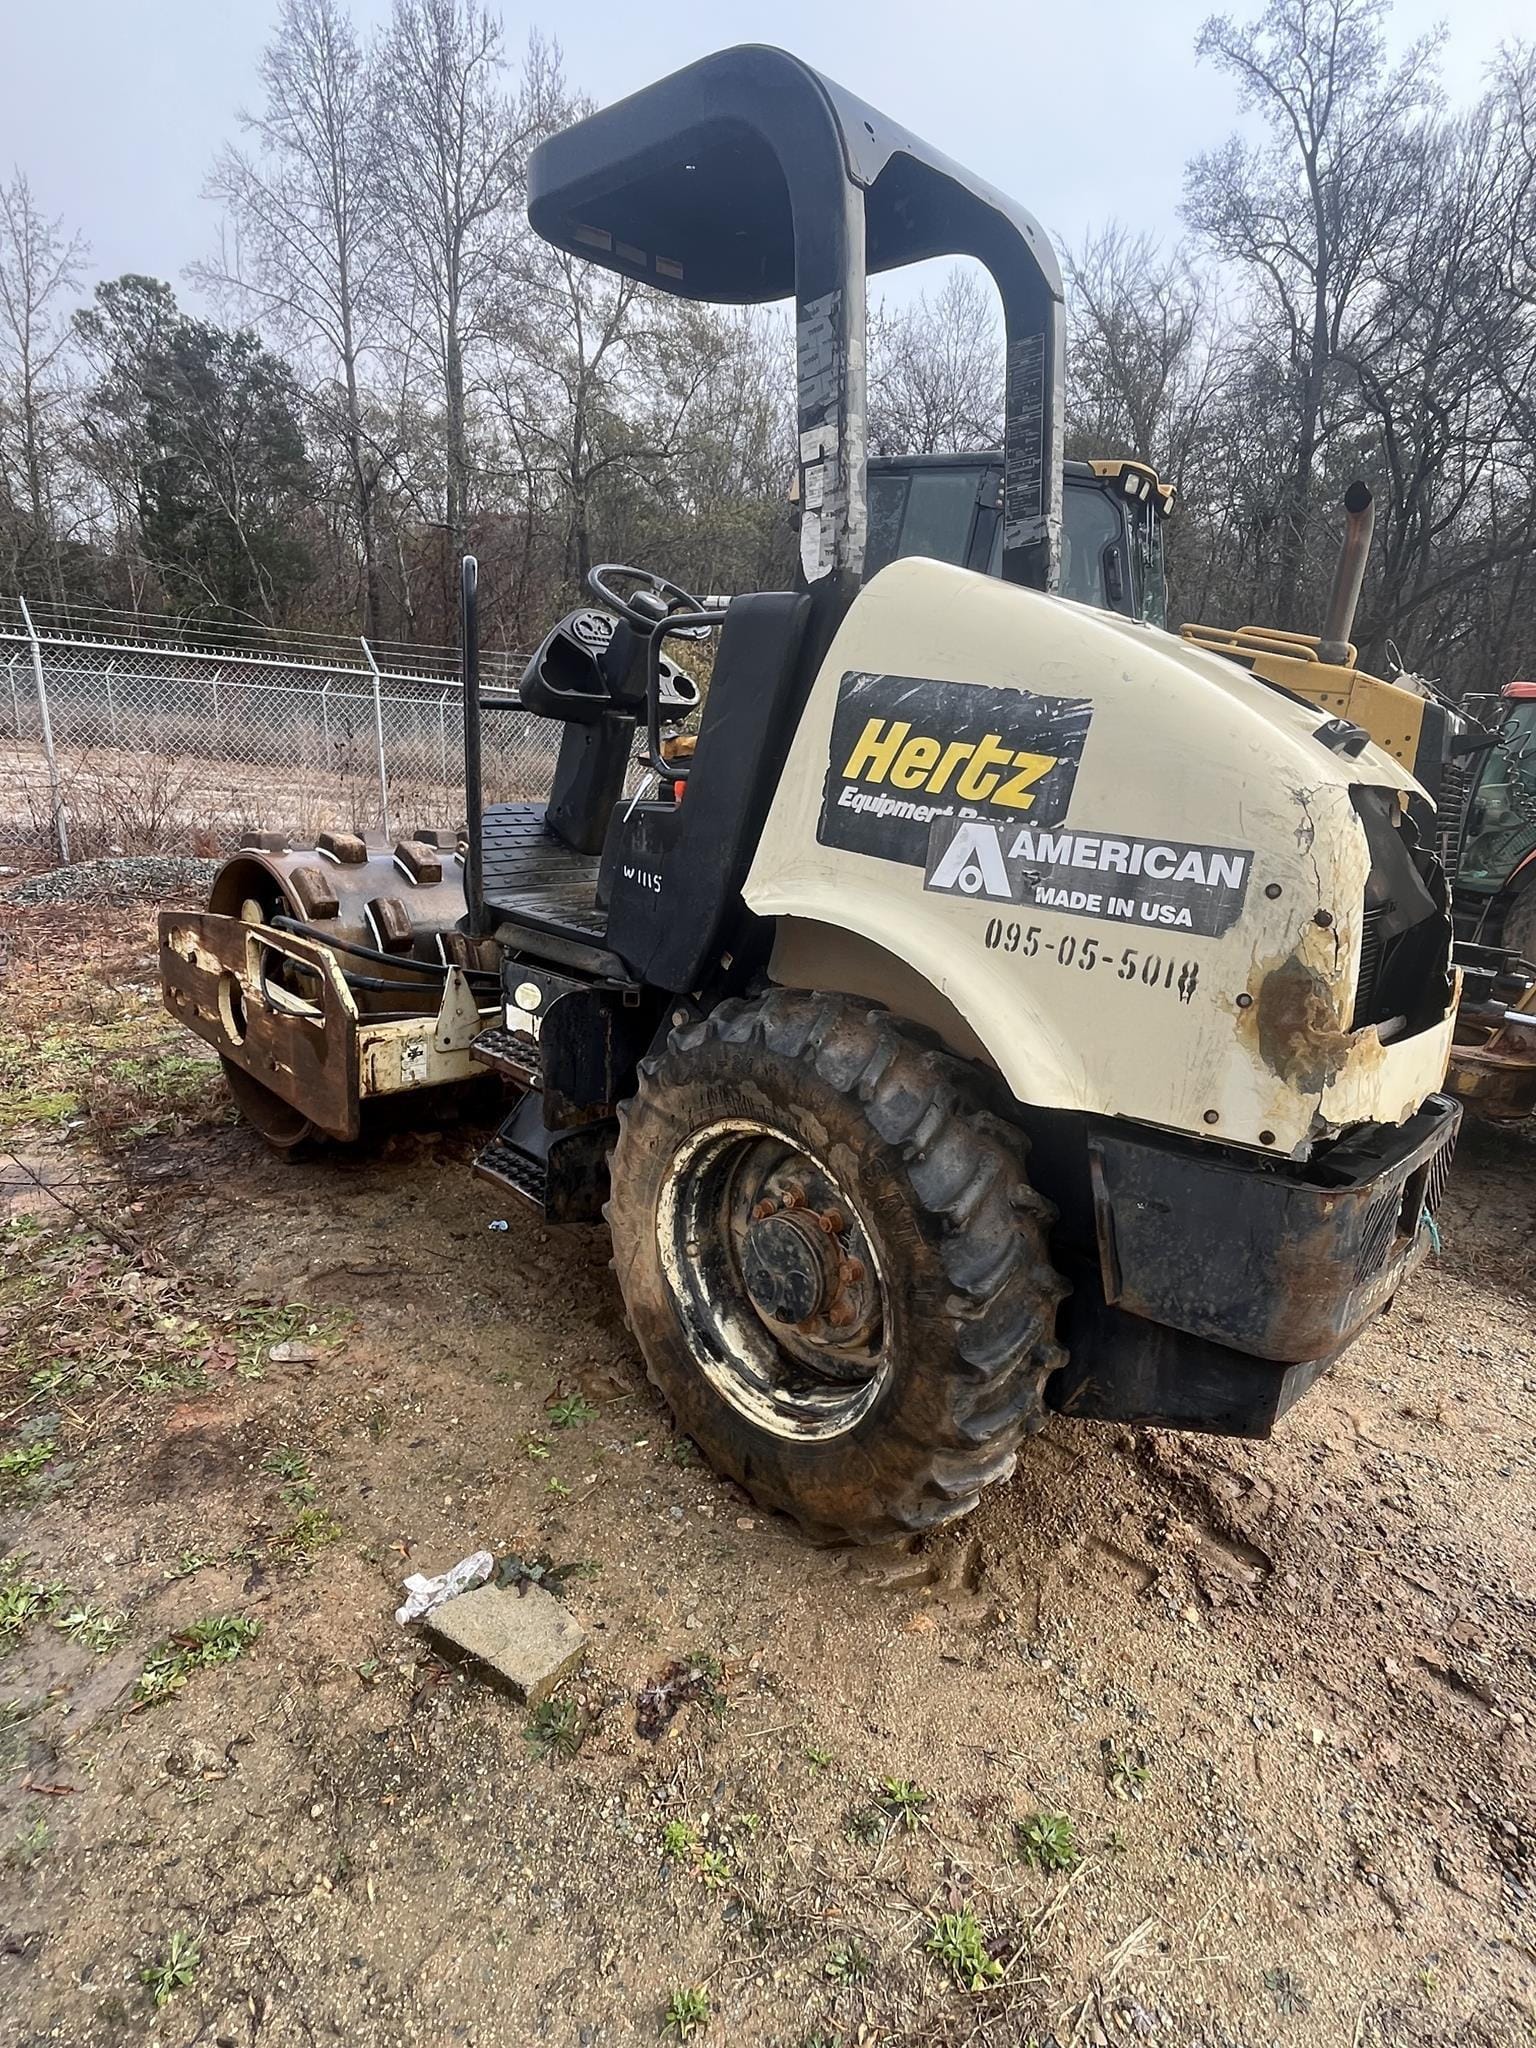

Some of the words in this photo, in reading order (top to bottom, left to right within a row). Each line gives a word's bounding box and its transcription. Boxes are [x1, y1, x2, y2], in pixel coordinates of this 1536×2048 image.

[842, 718, 1058, 810] Hertz
[1008, 830, 1245, 889] AMERICAN
[1035, 886, 1102, 913] MADE
[1107, 897, 1135, 918] IN
[1140, 902, 1193, 927] USA
[985, 917, 1199, 1004] 095-05-5018
